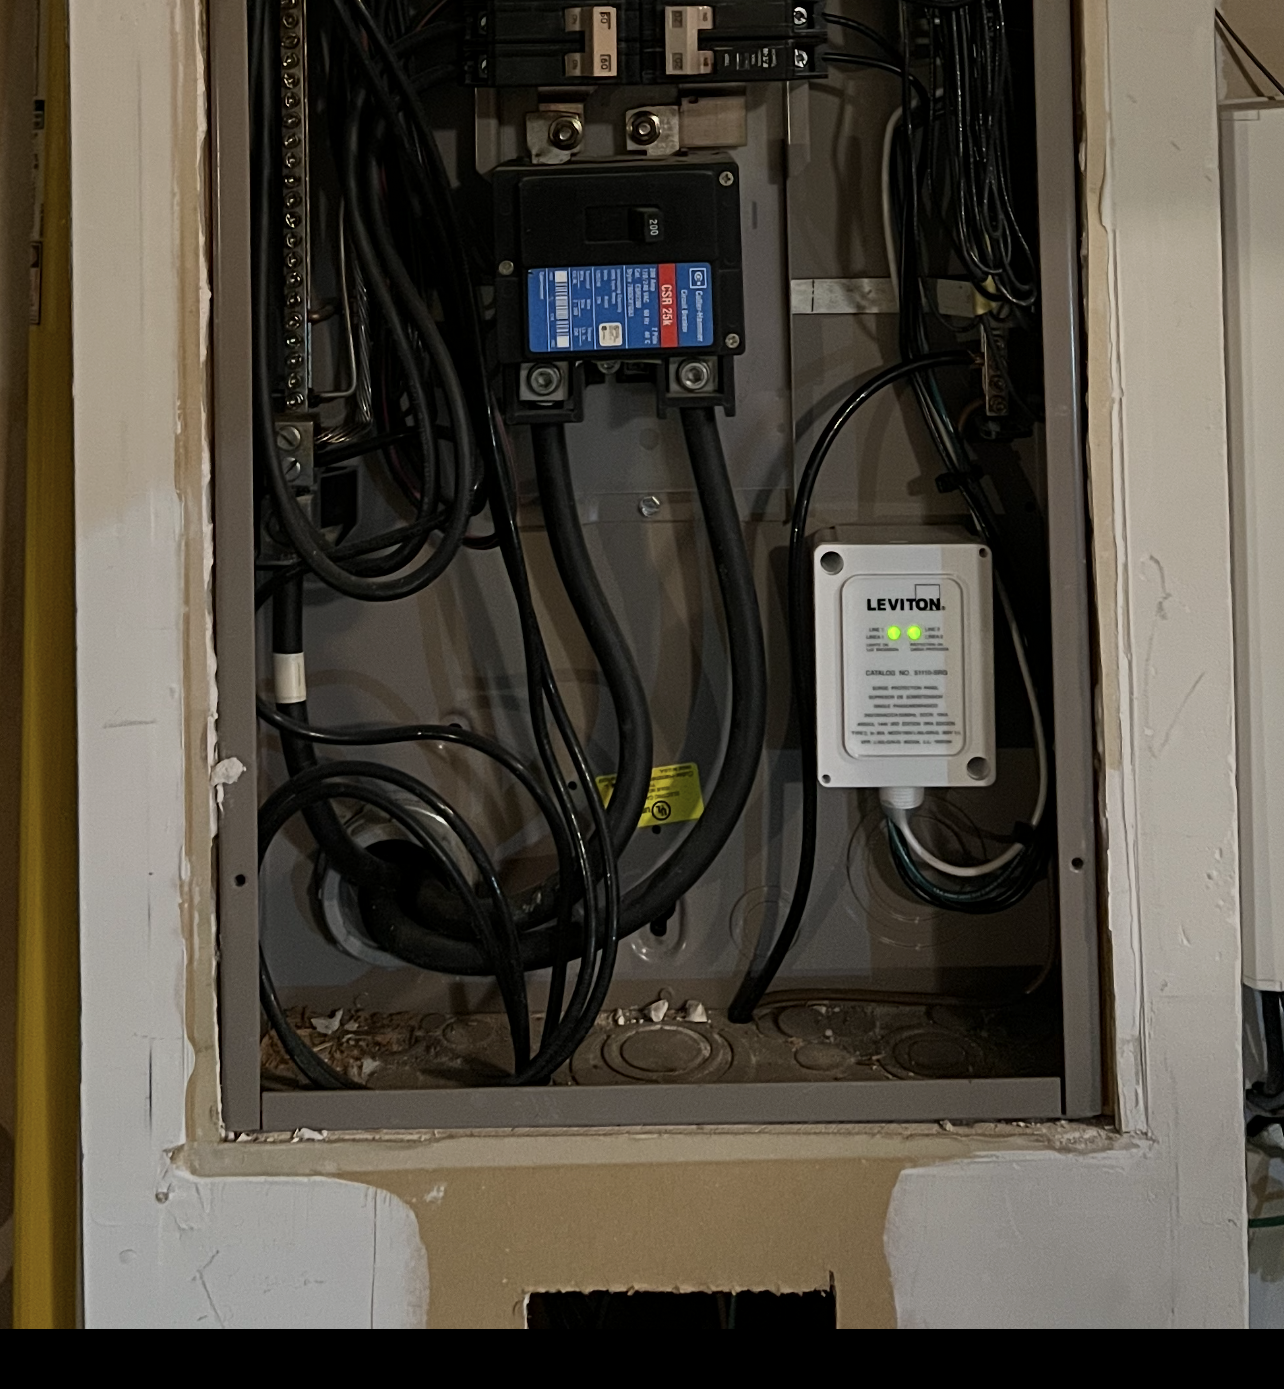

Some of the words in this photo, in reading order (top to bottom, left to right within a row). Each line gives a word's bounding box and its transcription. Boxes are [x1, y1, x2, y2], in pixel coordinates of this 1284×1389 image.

[649, 219, 659, 235] 200
[661, 284, 673, 305] CSR
[662, 308, 673, 325] 25k
[867, 598, 941, 611] LEVITON
